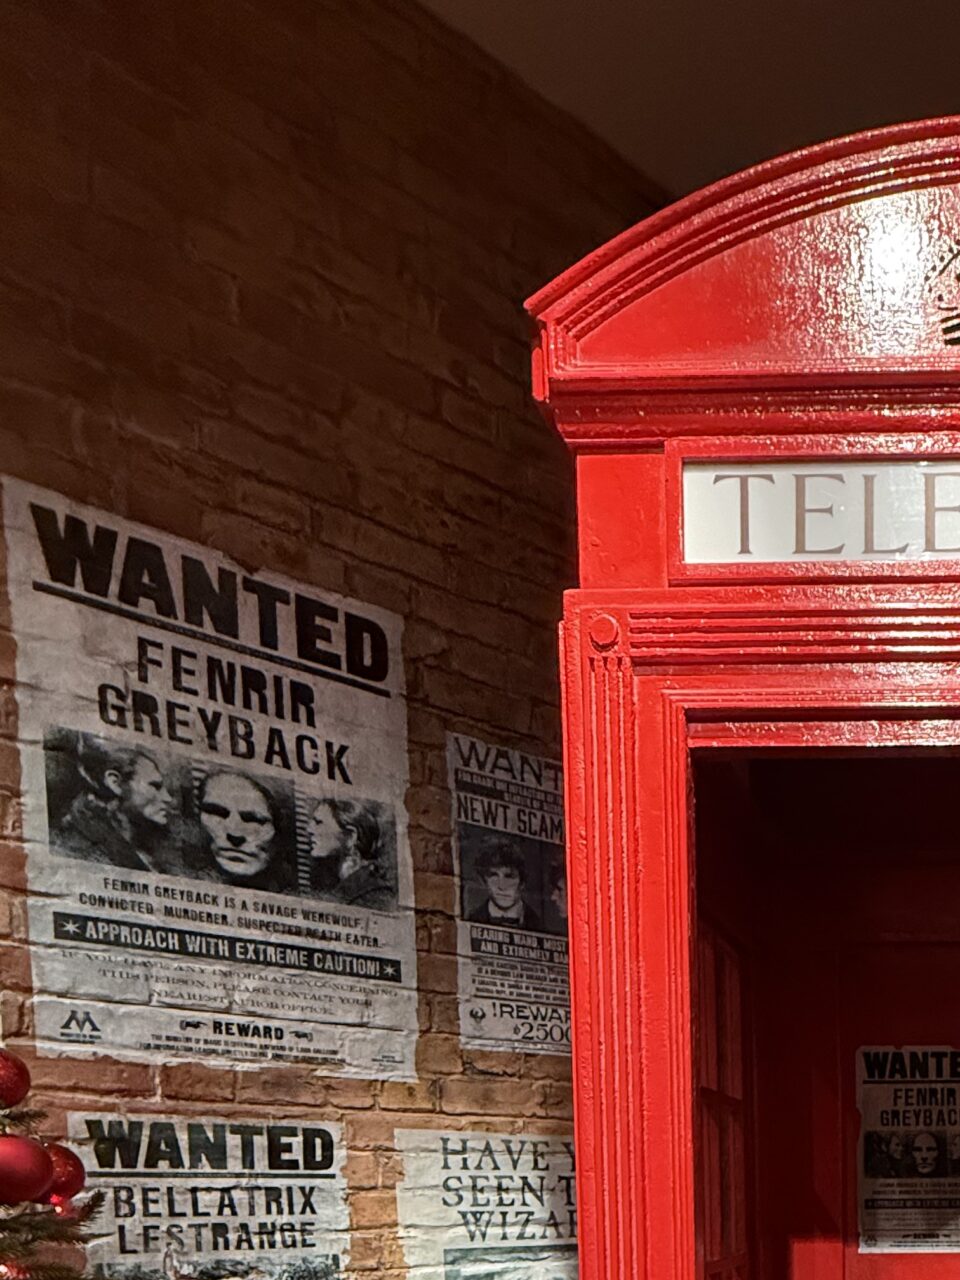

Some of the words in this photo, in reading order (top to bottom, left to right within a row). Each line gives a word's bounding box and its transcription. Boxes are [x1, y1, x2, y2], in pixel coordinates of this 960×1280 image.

[30, 502, 390, 682] WANTED
[137, 636, 316, 728] FENRIR
[97, 683, 352, 785] GREYBACK
[457, 794, 510, 829] NEWT
[79, 892, 153, 915] CONVICTED
[104, 877, 149, 896] FENRIR
[155, 886, 218, 908] GREYBACK
[225, 896, 236, 909] IS
[241, 900, 248, 911] A
[253, 902, 297, 919] SAVAGE
[85, 921, 179, 950] APPROACH
[186, 934, 229, 957] WITH
[235, 942, 308, 967] EXTREME
[313, 952, 380, 976] CAUTION!
[480, 941, 499, 954] AND
[213, 1020, 284, 1040] REWARD
[893, 1088, 956, 1106] FENRIR
[86, 1119, 335, 1171] WANTED
[440, 1137, 549, 1171] HAVE
[113, 1186, 317, 1218] BELLATRIX
[442, 1175, 545, 1207] SEEN
[117, 1222, 317, 1255] LESTRANGE
